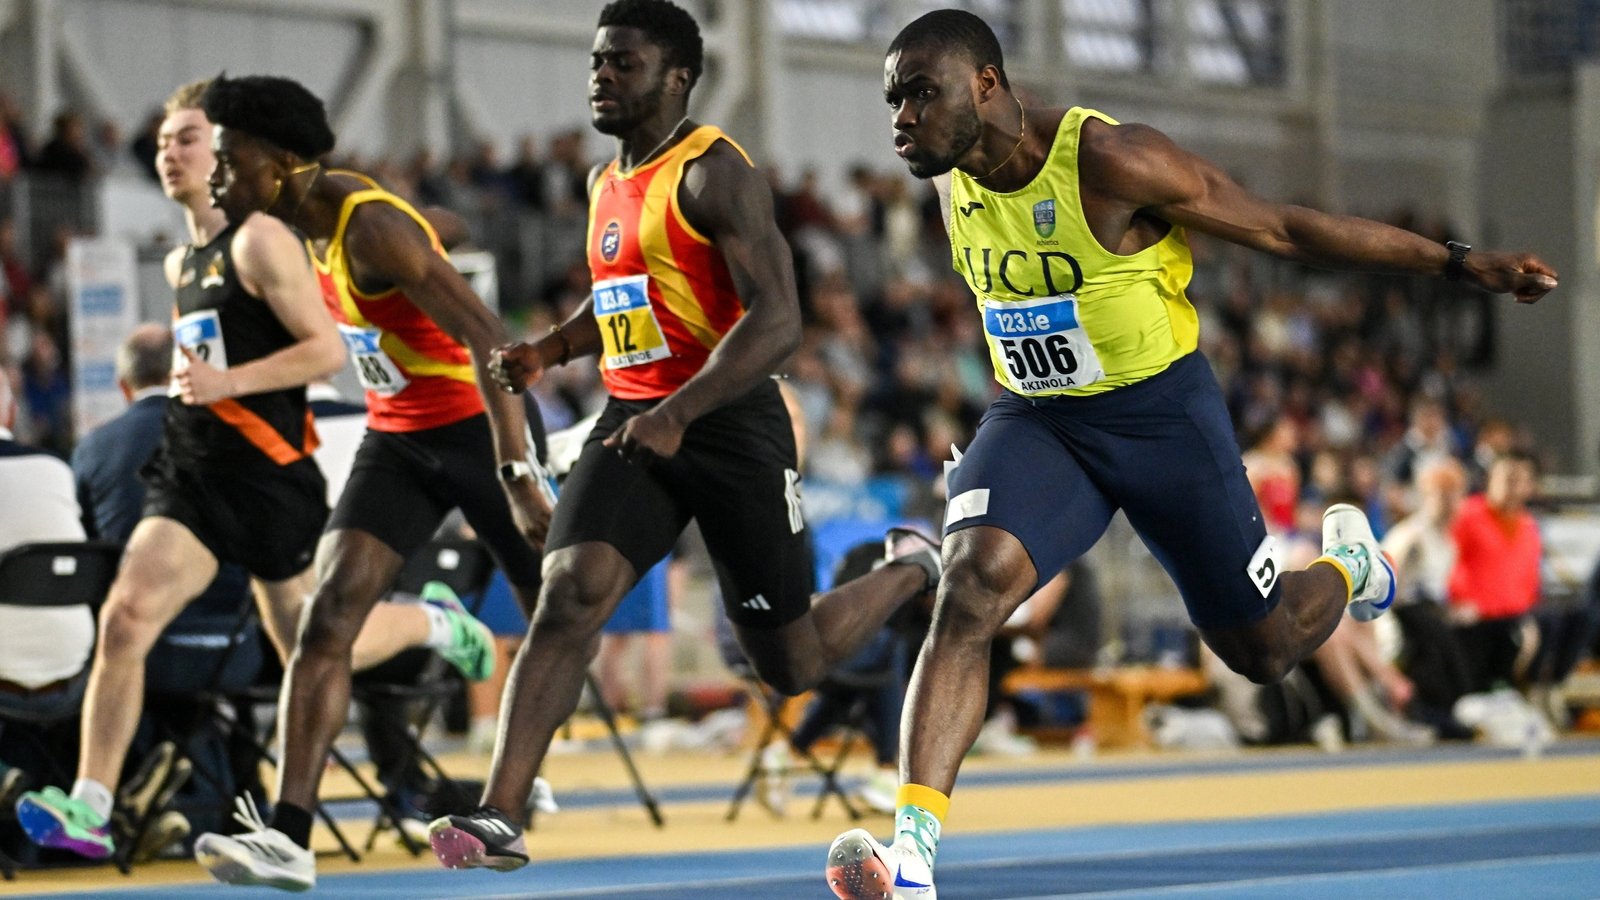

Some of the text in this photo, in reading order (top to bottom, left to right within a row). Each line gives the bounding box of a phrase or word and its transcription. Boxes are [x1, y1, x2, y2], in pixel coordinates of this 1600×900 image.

[963, 247, 1084, 297] UCD
[598, 287, 631, 310] 123.ie
[608, 313, 637, 353] 12
[994, 311, 1050, 333] 123.ie
[1000, 334, 1078, 380] 506
[1021, 376, 1076, 391] AKINOLA
[1256, 557, 1275, 588] 5
